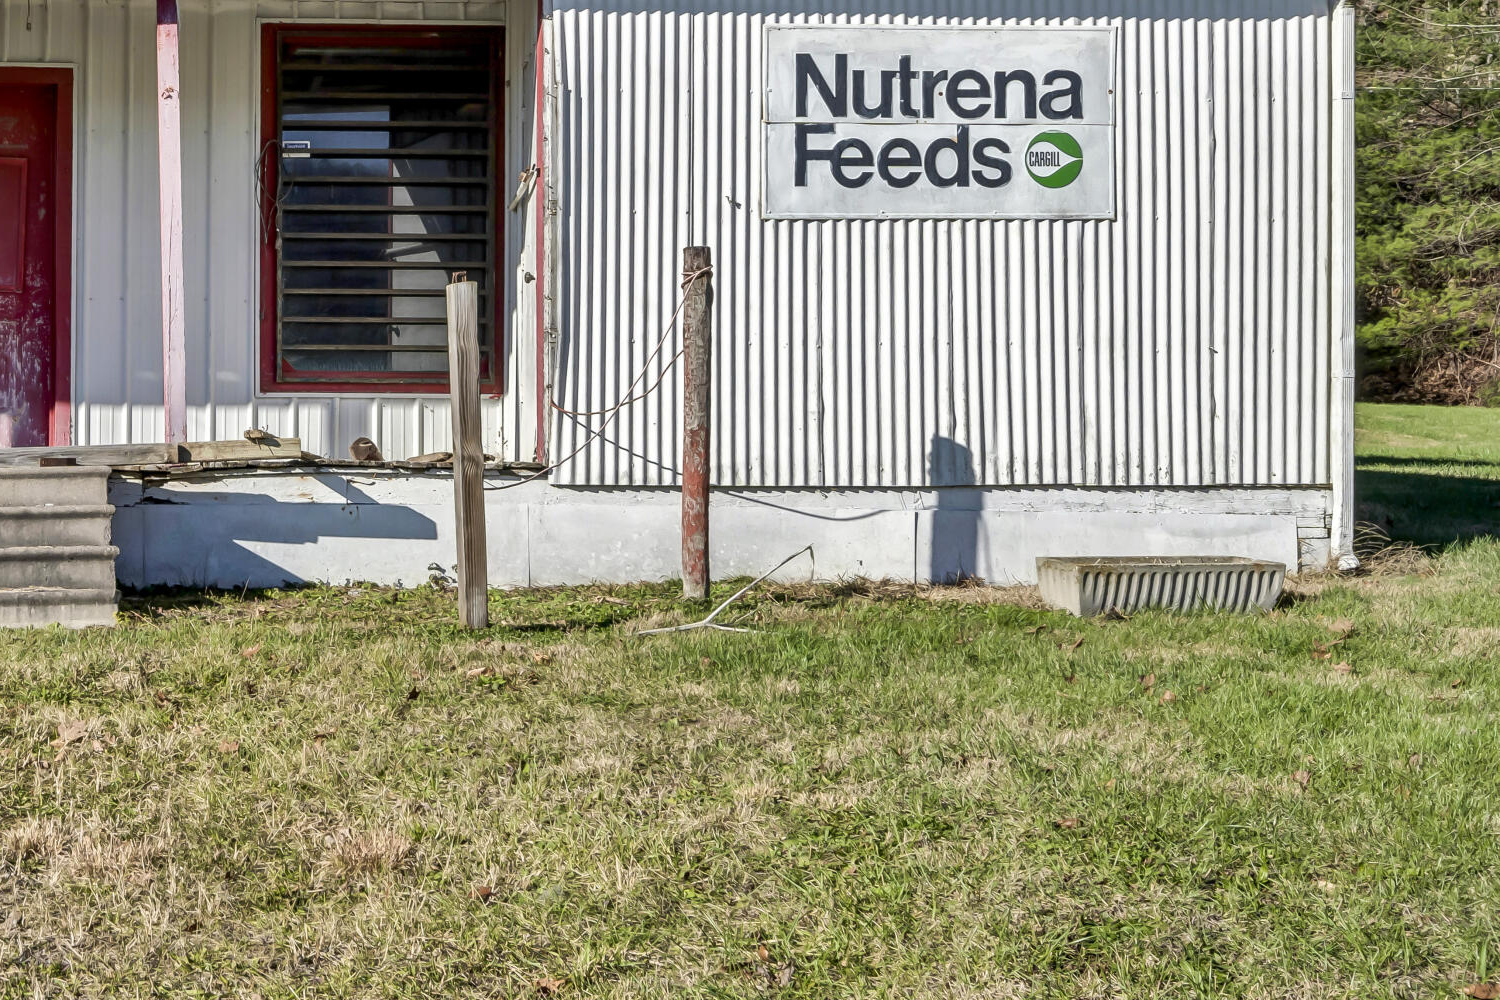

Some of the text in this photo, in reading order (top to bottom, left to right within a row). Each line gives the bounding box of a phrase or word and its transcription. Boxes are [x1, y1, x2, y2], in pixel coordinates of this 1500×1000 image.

[795, 53, 1084, 119] Nutrena
[794, 122, 1014, 188] Feeds
[1028, 151, 1061, 167] CARGILL
